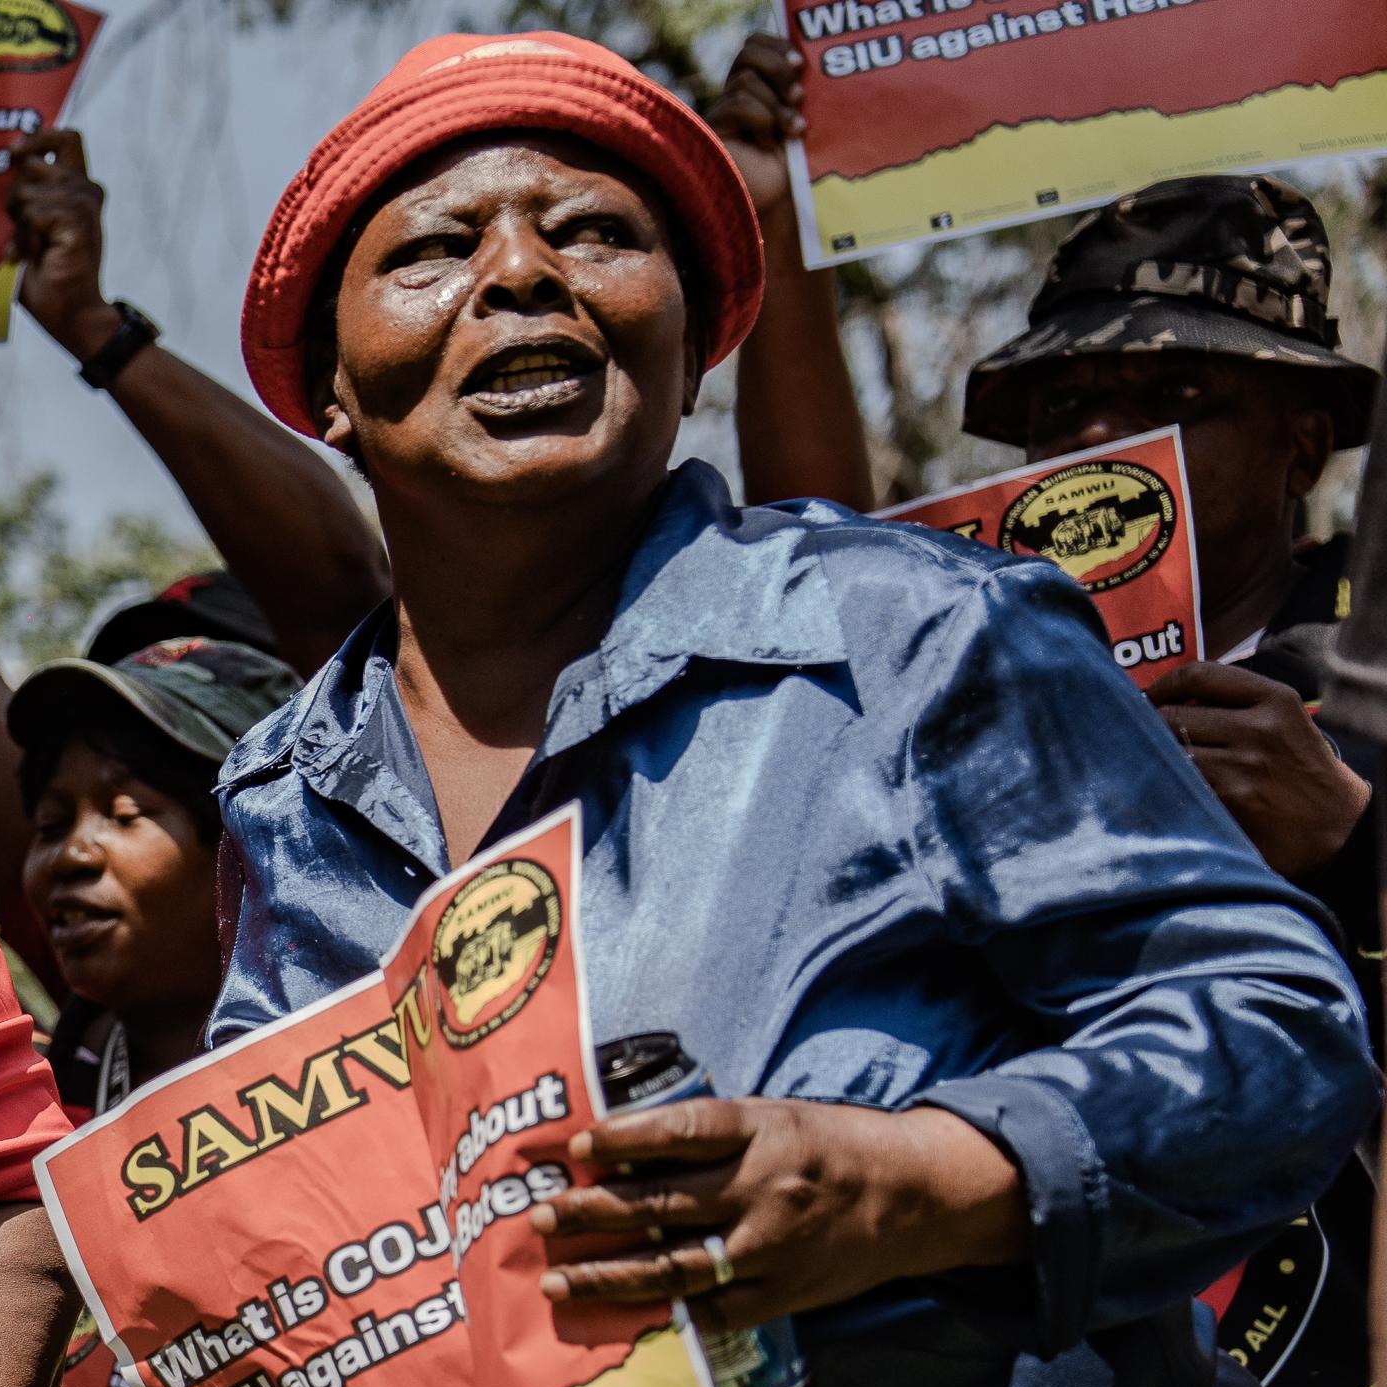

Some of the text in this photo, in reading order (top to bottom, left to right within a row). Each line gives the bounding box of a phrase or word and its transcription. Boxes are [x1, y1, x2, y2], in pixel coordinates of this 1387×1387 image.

[797, 0, 924, 39] What
[823, 34, 903, 77] SIU
[911, 1, 1086, 59] against
[1040, 463, 1105, 491] MUNICIPAL
[1045, 479, 1116, 505] SAMWU
[271, 1277, 326, 1329] is
[327, 1203, 453, 1295] COJ
[456, 1074, 567, 1174] about
[454, 1163, 570, 1257] Botes
[1244, 1304, 1288, 1353] ALL
